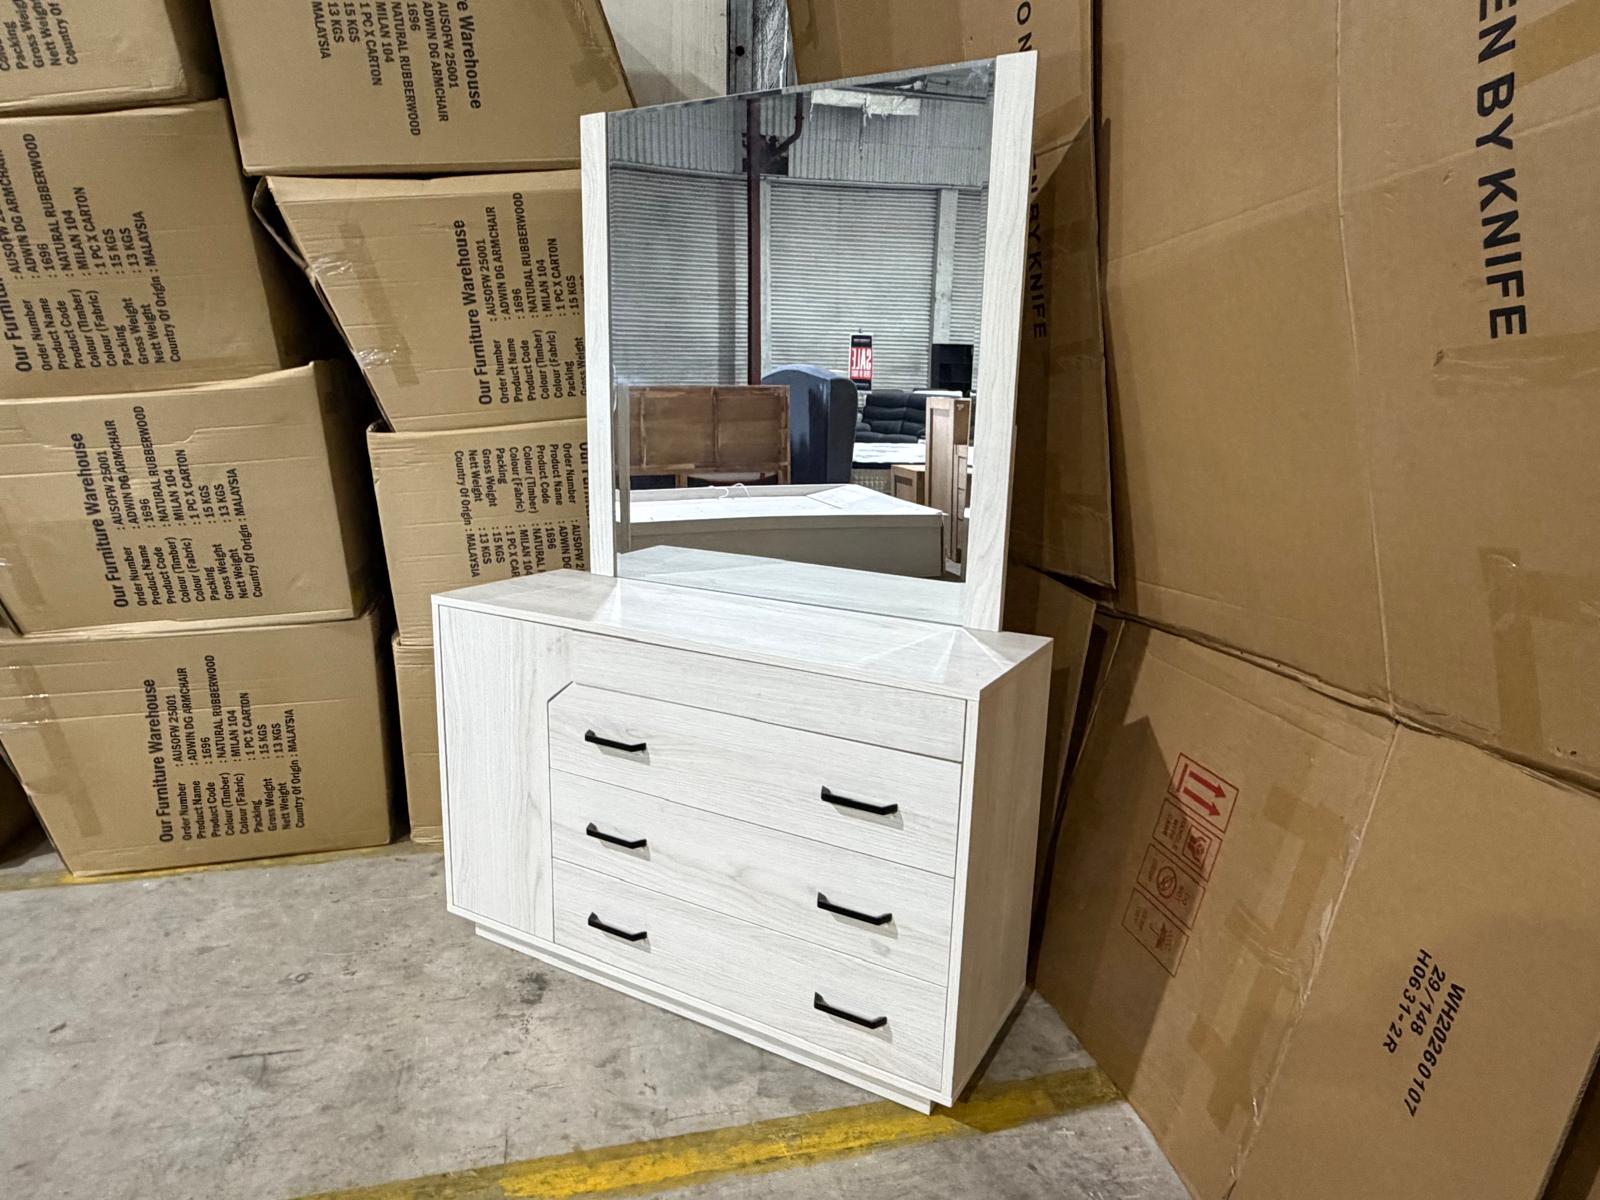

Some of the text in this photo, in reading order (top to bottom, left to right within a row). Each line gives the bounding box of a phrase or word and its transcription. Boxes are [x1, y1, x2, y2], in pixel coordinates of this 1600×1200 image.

[4, 21, 28, 70] Packing
[28, 34, 45, 68] Gross
[45, 41, 62, 66] Nett
[48, 3, 78, 65] Country Of
[311, 1, 332, 59] MALAYSIA
[327, 2, 345, 43] 13 KGS
[343, 2, 361, 43] 15 KGS
[361, 11, 374, 28] PC
[364, 29, 376, 38] X
[365, 39, 382, 86] CARTON
[375, 1, 395, 63] MILAN 104
[391, 1, 421, 136] NATURAL RUBBERWOOD
[406, 2, 421, 32] 1696
[422, 1, 449, 122] ADWIN DG ARMCHAIR
[437, 1, 460, 89] AUSOFW 25001
[458, 15, 482, 109] Warehouse
[1476, 72, 1515, 150] BY
[22, 133, 102, 368] Colour (Timber) NATURAL RUBBERWOOD
[61, 209, 118, 367] Colour (Fabric) MILAN 104
[102, 228, 150, 365] Gross Weight 15 KGS
[132, 211, 181, 363] Country Of Origin MALAYSIA
[512, 192, 550, 400] Colour (Timber) NATURAL RUBBERWOOD
[547, 238, 562, 279] CARTON
[552, 280, 563, 288] X
[554, 289, 565, 303] PC
[1029, 252, 1047, 338] KNIFE
[1478, 168, 1527, 339] KNIFE
[36, 243, 86, 369] Product Code 1696
[453, 220, 493, 405] Our Furniture Warehouse
[475, 238, 510, 404] Order Number AUSOFW 25001
[485, 206, 524, 403] Product Name ADWIN DG ARMCHAIR
[511, 288, 537, 402] Product Code 1696
[535, 259, 564, 399] Colour (Fabric) MILAN 104
[564, 360, 577, 398] Packing
[70, 433, 129, 608] Our Furniture Warehouse
[104, 420, 163, 606] Product Name ADWIN DG ARMCHAIR
[133, 406, 192, 603] Colour (Timber) NATURAL RUBBERWOOD
[174, 449, 193, 489] CARTON
[186, 498, 198, 512] PC
[454, 450, 481, 578] Country Of Origin MALAYSIA
[468, 449, 492, 565] Nett Weight 13 KGS
[481, 448, 506, 564] Gross Weight 15 KGS
[536, 444, 557, 550] Product Code 1696
[96, 450, 148, 607] Order Number AUSOFW 25001
[139, 498, 177, 605] Product Code 1696
[163, 469, 206, 602] Colour (Fabric) MILAN 104
[198, 485, 235, 600] Gross Weight 15 KGS
[213, 483, 249, 599] Nett Weight 13 KGS
[226, 468, 263, 598] Country Of Origin MALAYSIA
[203, 566, 221, 601] Packing
[165, 694, 183, 763] AUSOFW 25001
[176, 667, 198, 761] ADWIN DG ARMCHAIR
[200, 736, 212, 759] 1696
[204, 655, 226, 759] NATURAL RUBBERWOOD
[284, 709, 297, 753] MALAYSIA
[143, 679, 174, 843] Our Furniture Warehouse
[1383, 949, 1432, 1054] H0631-2R
[1404, 984, 1465, 1116] WH20260107
[1411, 965, 1445, 1036] 29/148
